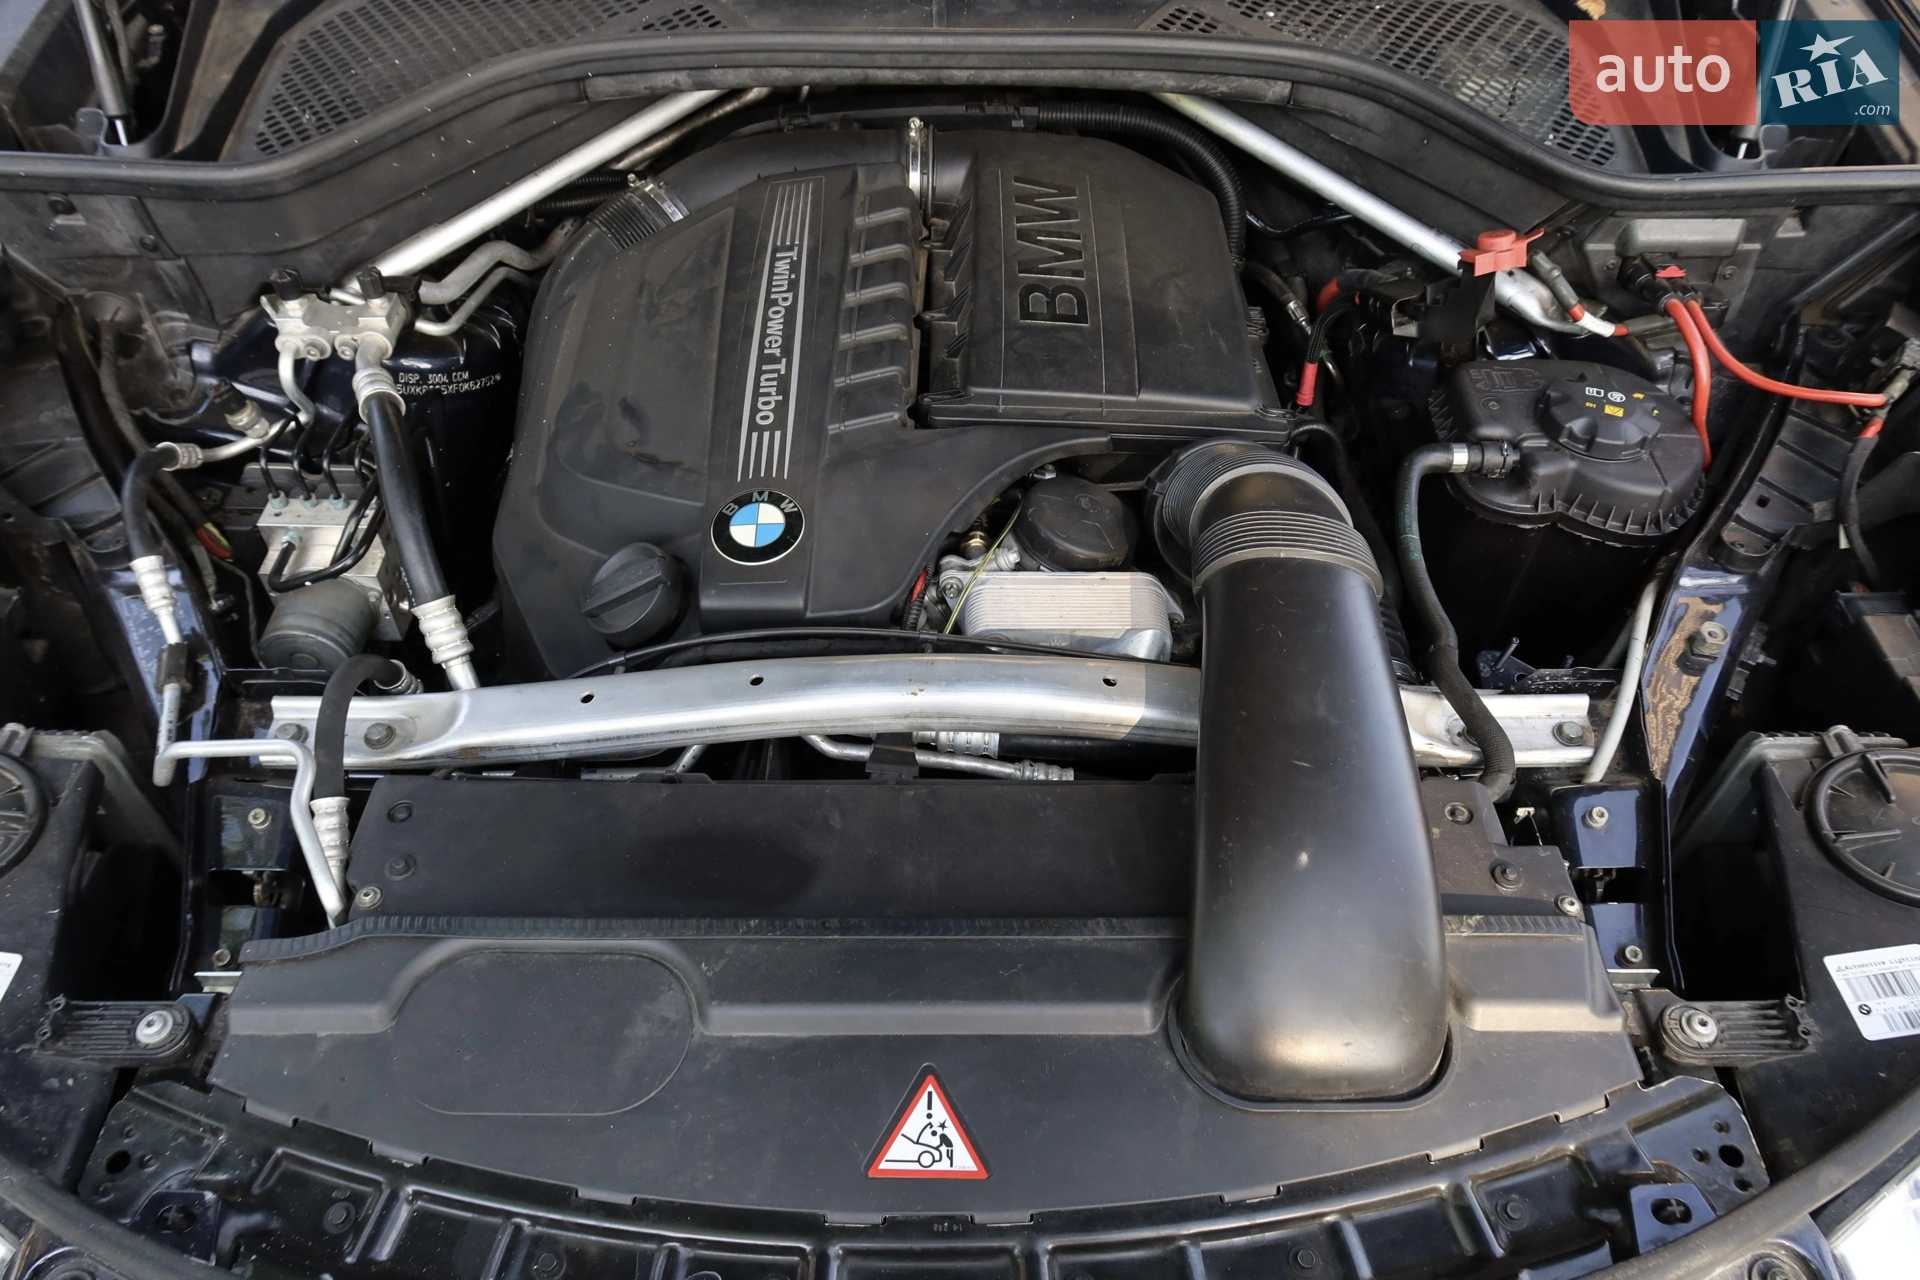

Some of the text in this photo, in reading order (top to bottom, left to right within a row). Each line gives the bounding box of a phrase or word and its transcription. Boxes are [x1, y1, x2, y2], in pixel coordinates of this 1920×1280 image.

[1012, 175, 1090, 327] BMW
[398, 370, 469, 384] DISP. 3004 CCM
[721, 491, 799, 517] BMW
